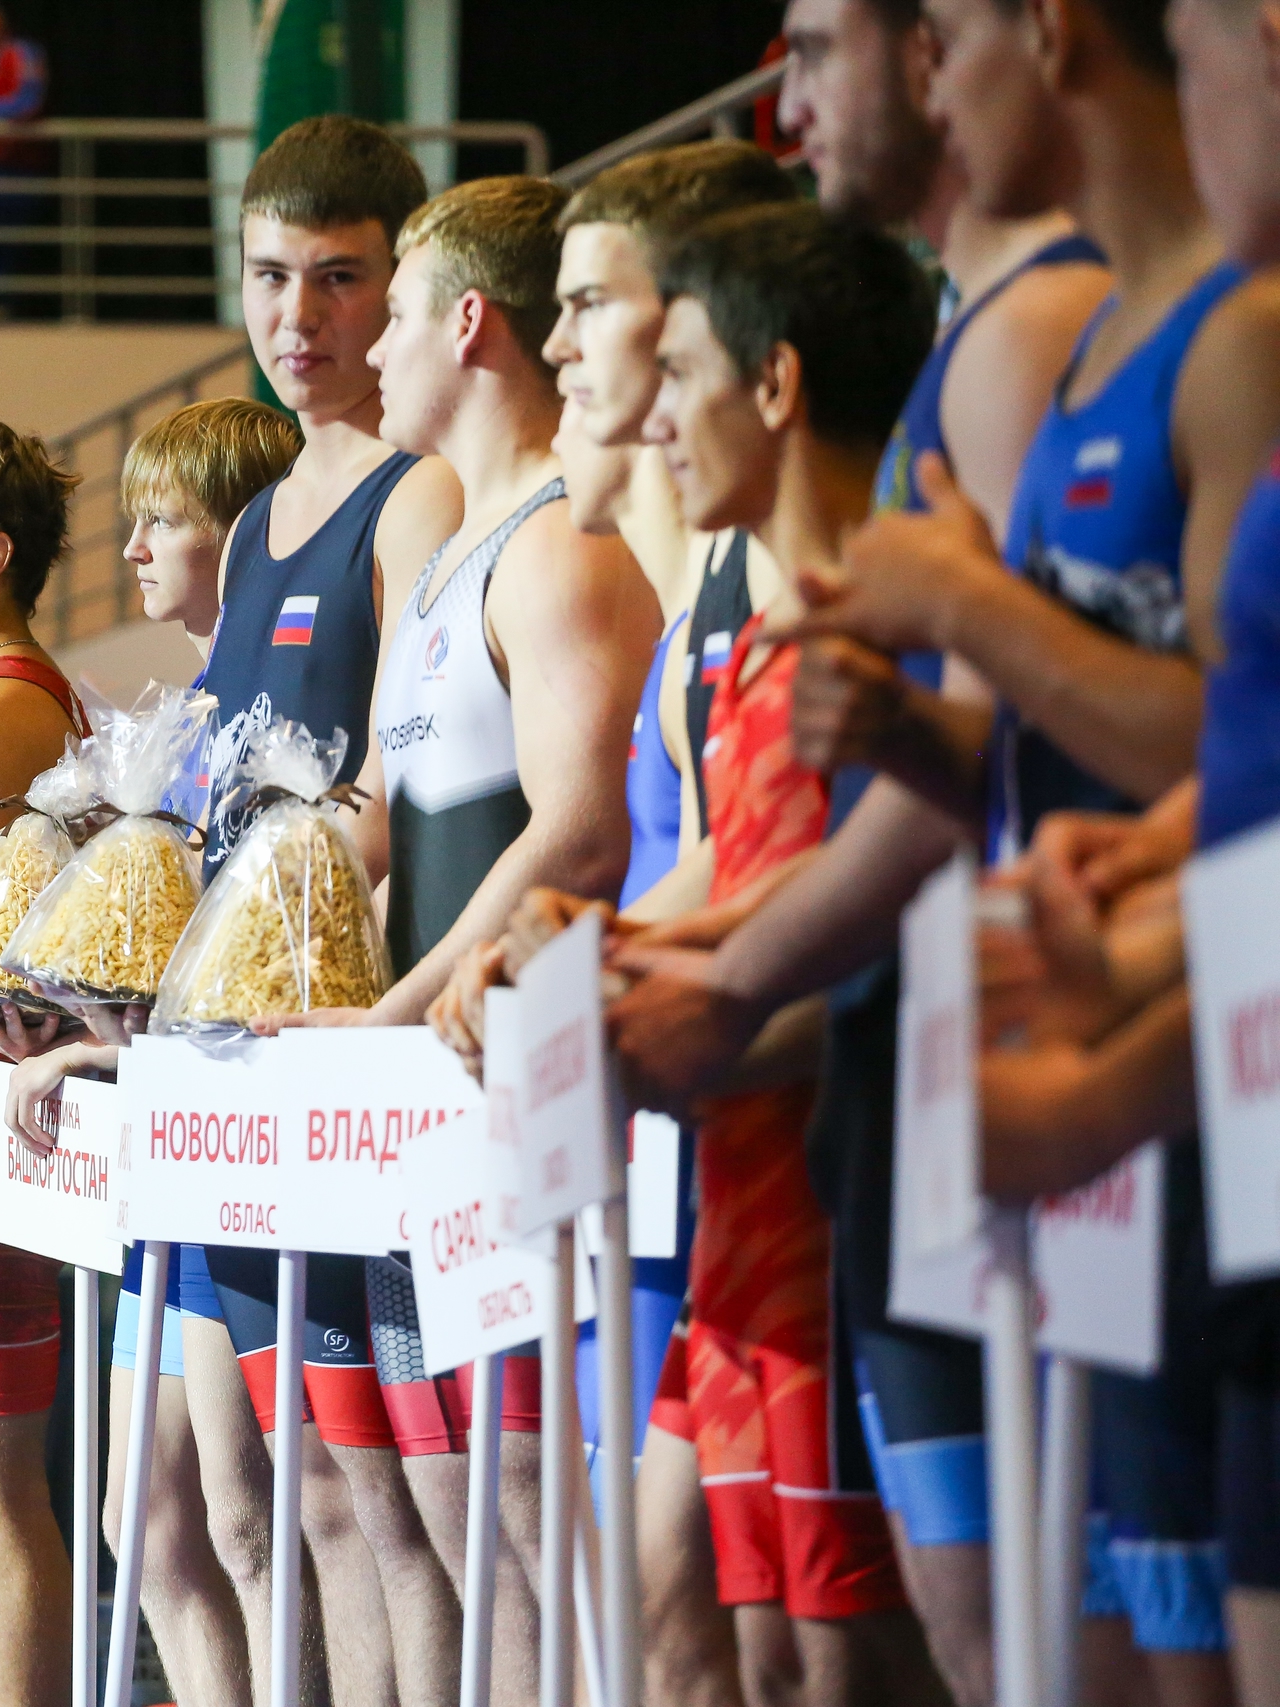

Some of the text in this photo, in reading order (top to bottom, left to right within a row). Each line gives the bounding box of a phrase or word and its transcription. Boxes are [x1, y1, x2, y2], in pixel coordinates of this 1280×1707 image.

[7, 1135, 108, 1202] БАШКОРТОСТАН
[431, 1200, 499, 1274] САРАТ
[330, 1335, 345, 1345] SF
